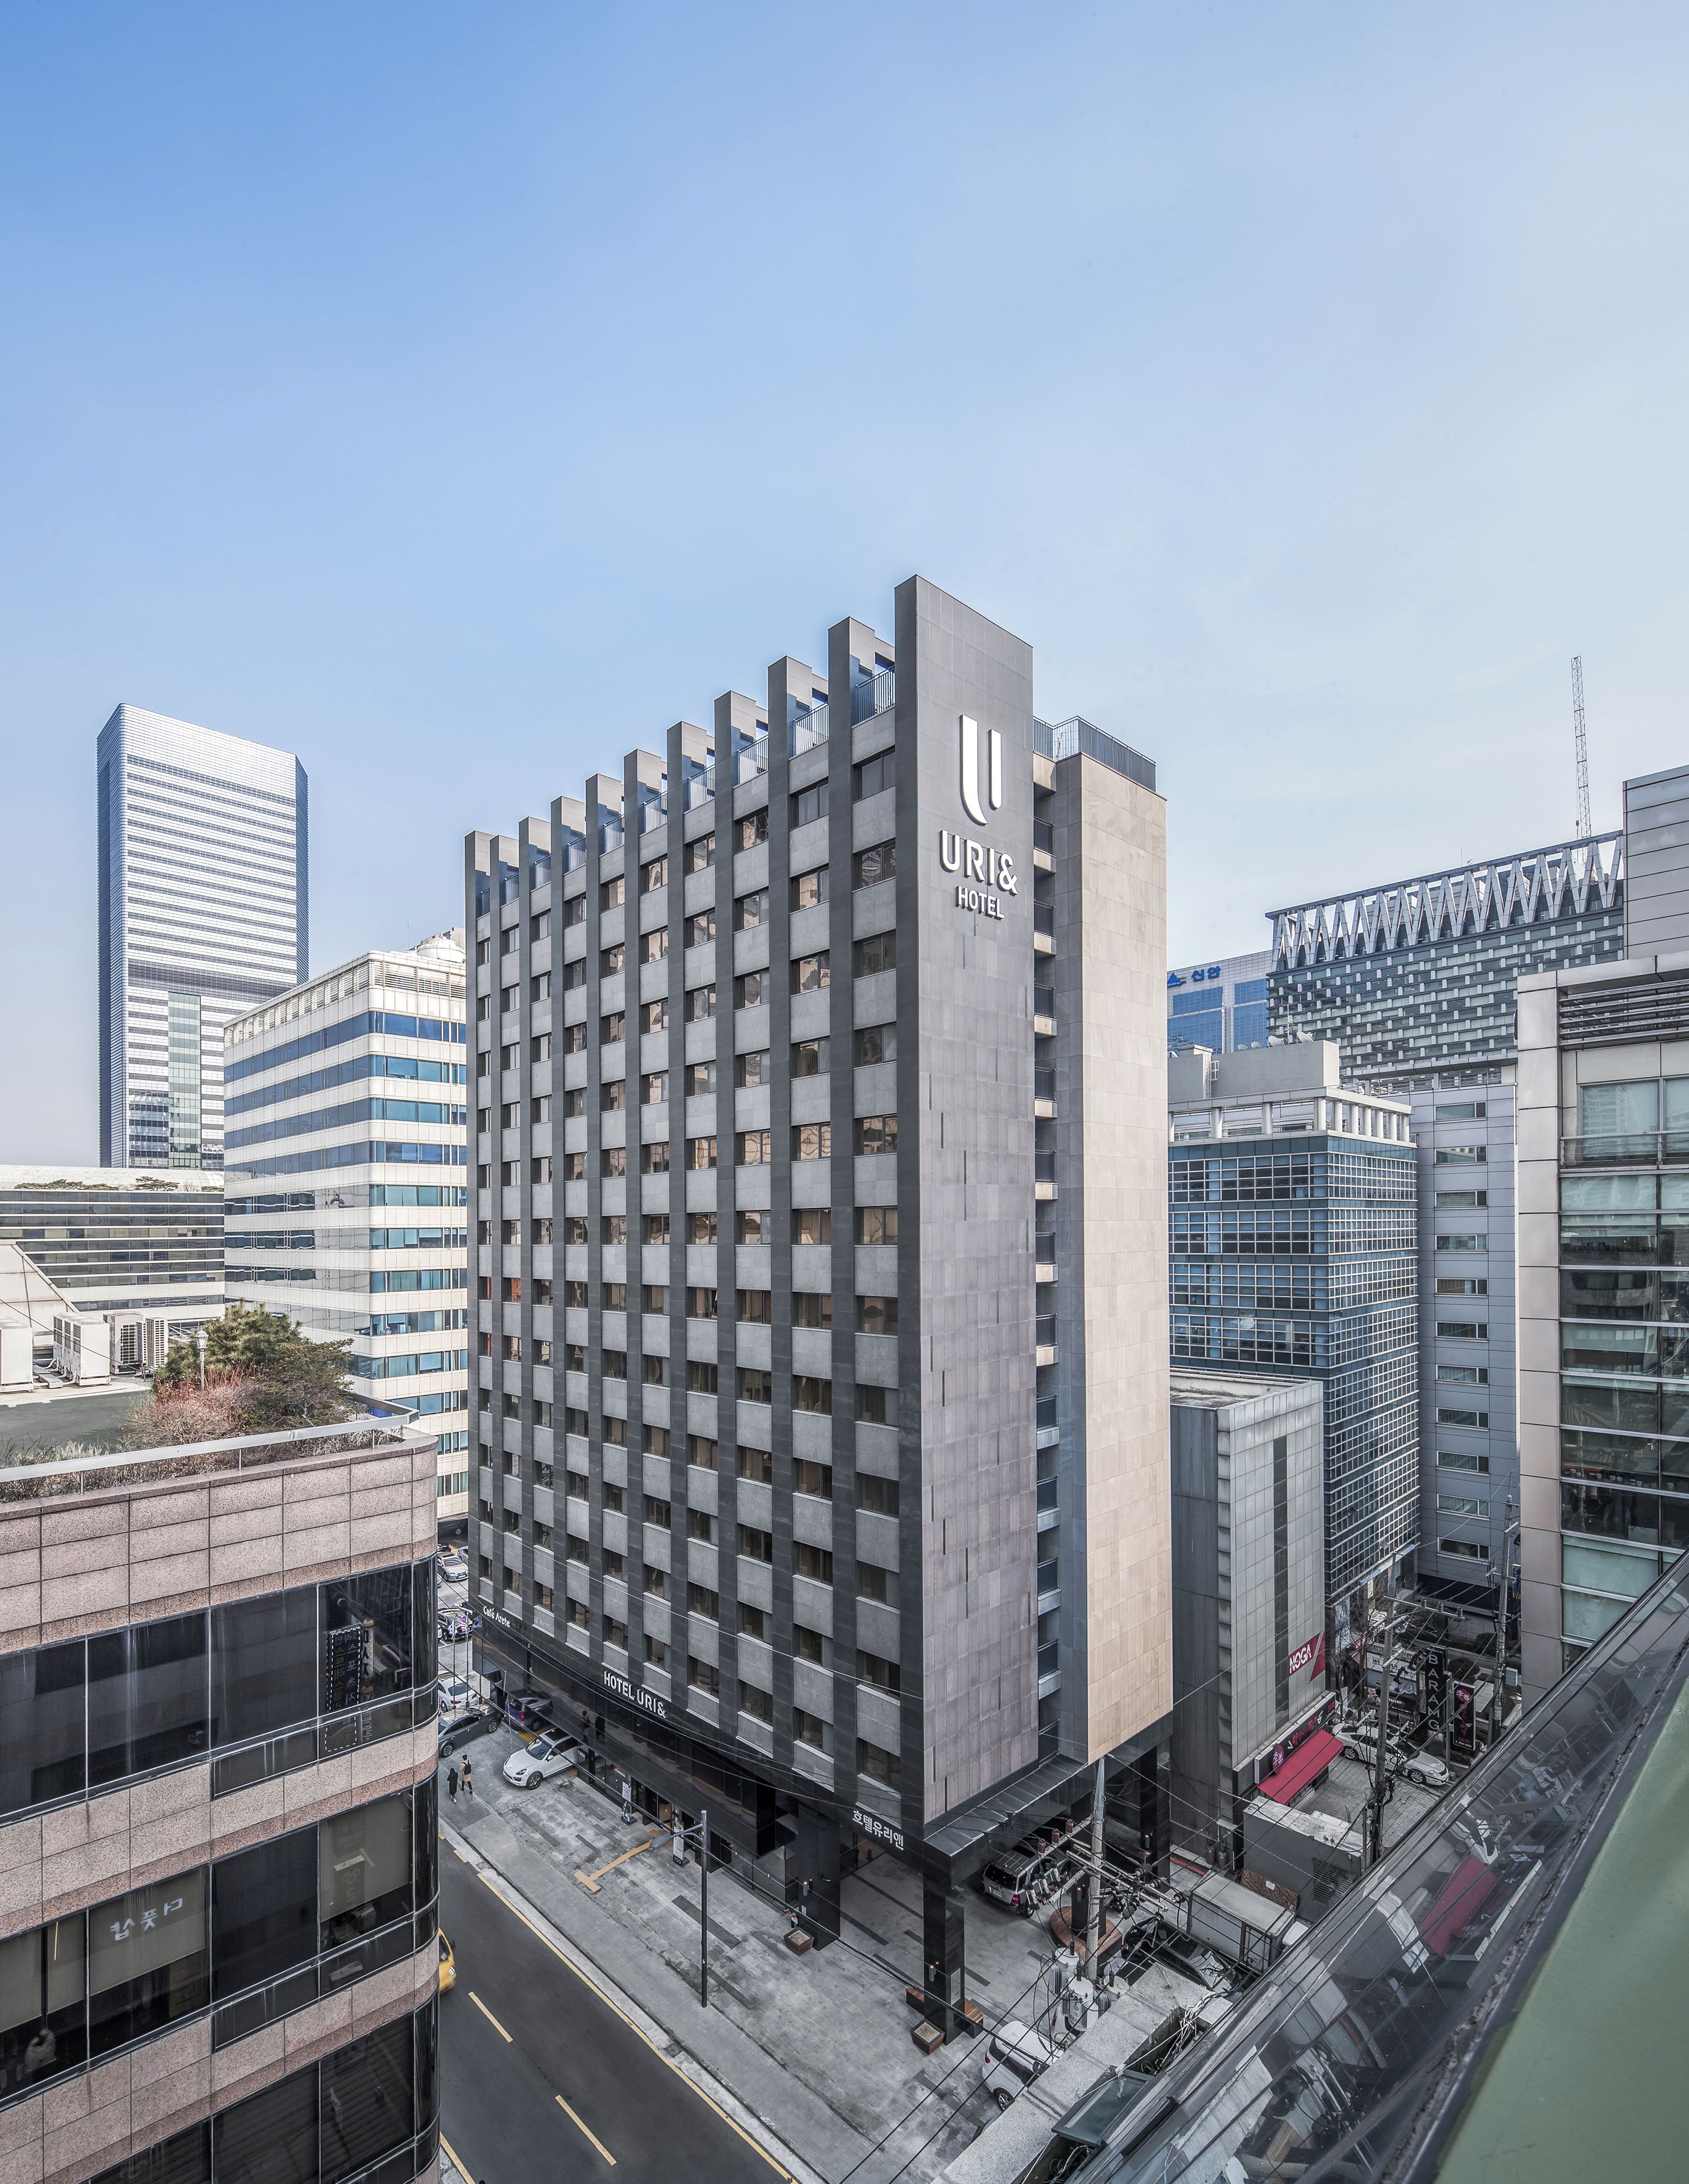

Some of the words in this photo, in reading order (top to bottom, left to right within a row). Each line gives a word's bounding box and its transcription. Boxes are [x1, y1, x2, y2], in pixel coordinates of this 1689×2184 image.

[940, 829, 1018, 896] URI&
[956, 885, 1005, 920] HOTEL
[1191, 966, 1221, 982] 신안
[483, 1606, 495, 1619] Café
[495, 1612, 510, 1628] Arete
[1289, 1644, 1312, 1674] NOGA
[603, 1670, 636, 1701] HOTEL
[636, 1689, 668, 1719] URI&
[852, 1810, 904, 1851] 호텔유리앤
